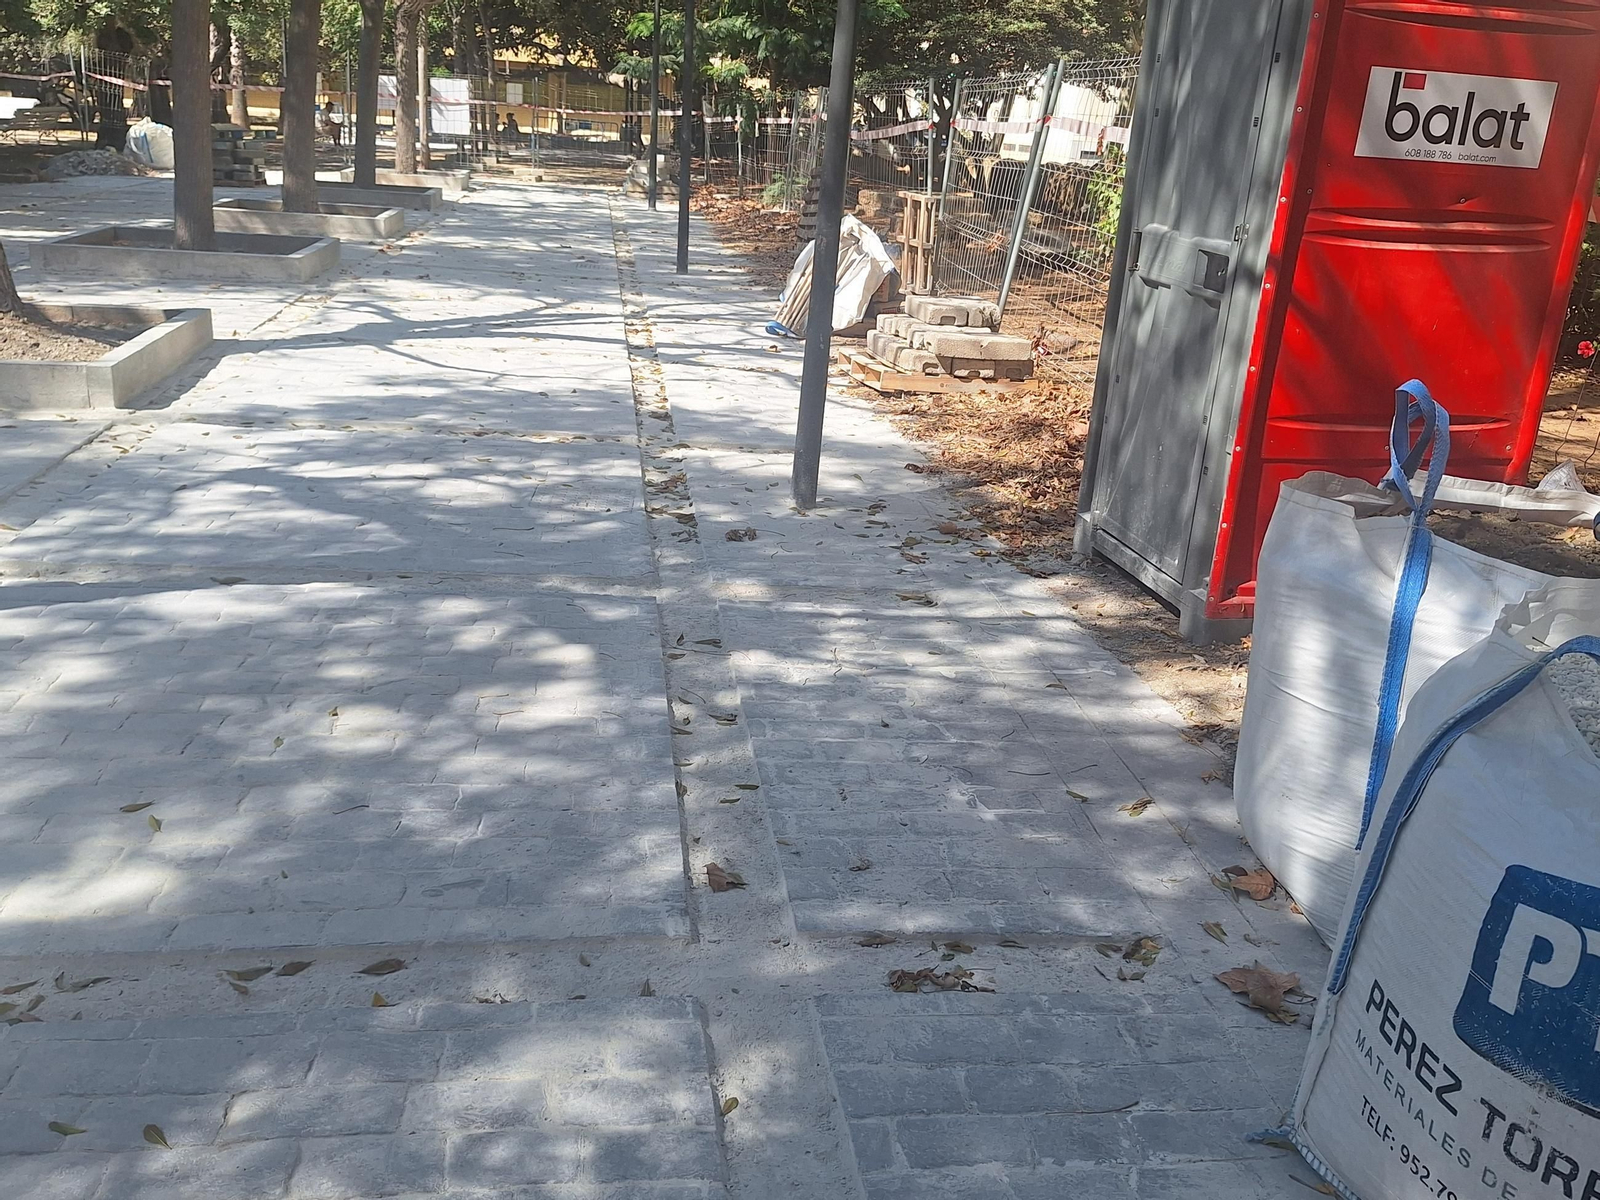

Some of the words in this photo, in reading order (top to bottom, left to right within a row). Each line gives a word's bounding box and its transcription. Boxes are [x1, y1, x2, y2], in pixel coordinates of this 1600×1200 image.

[1385, 71, 1530, 150] balat
[1404, 148, 1421, 158] 608
[1423, 149, 1436, 159] 188
[1438, 150, 1452, 160] 786
[1457, 152, 1497, 163] balat.com
[1366, 978, 1463, 1117] PEREZ
[1355, 1028, 1471, 1169] MATERIALES
[1361, 1094, 1396, 1151] TELF:
